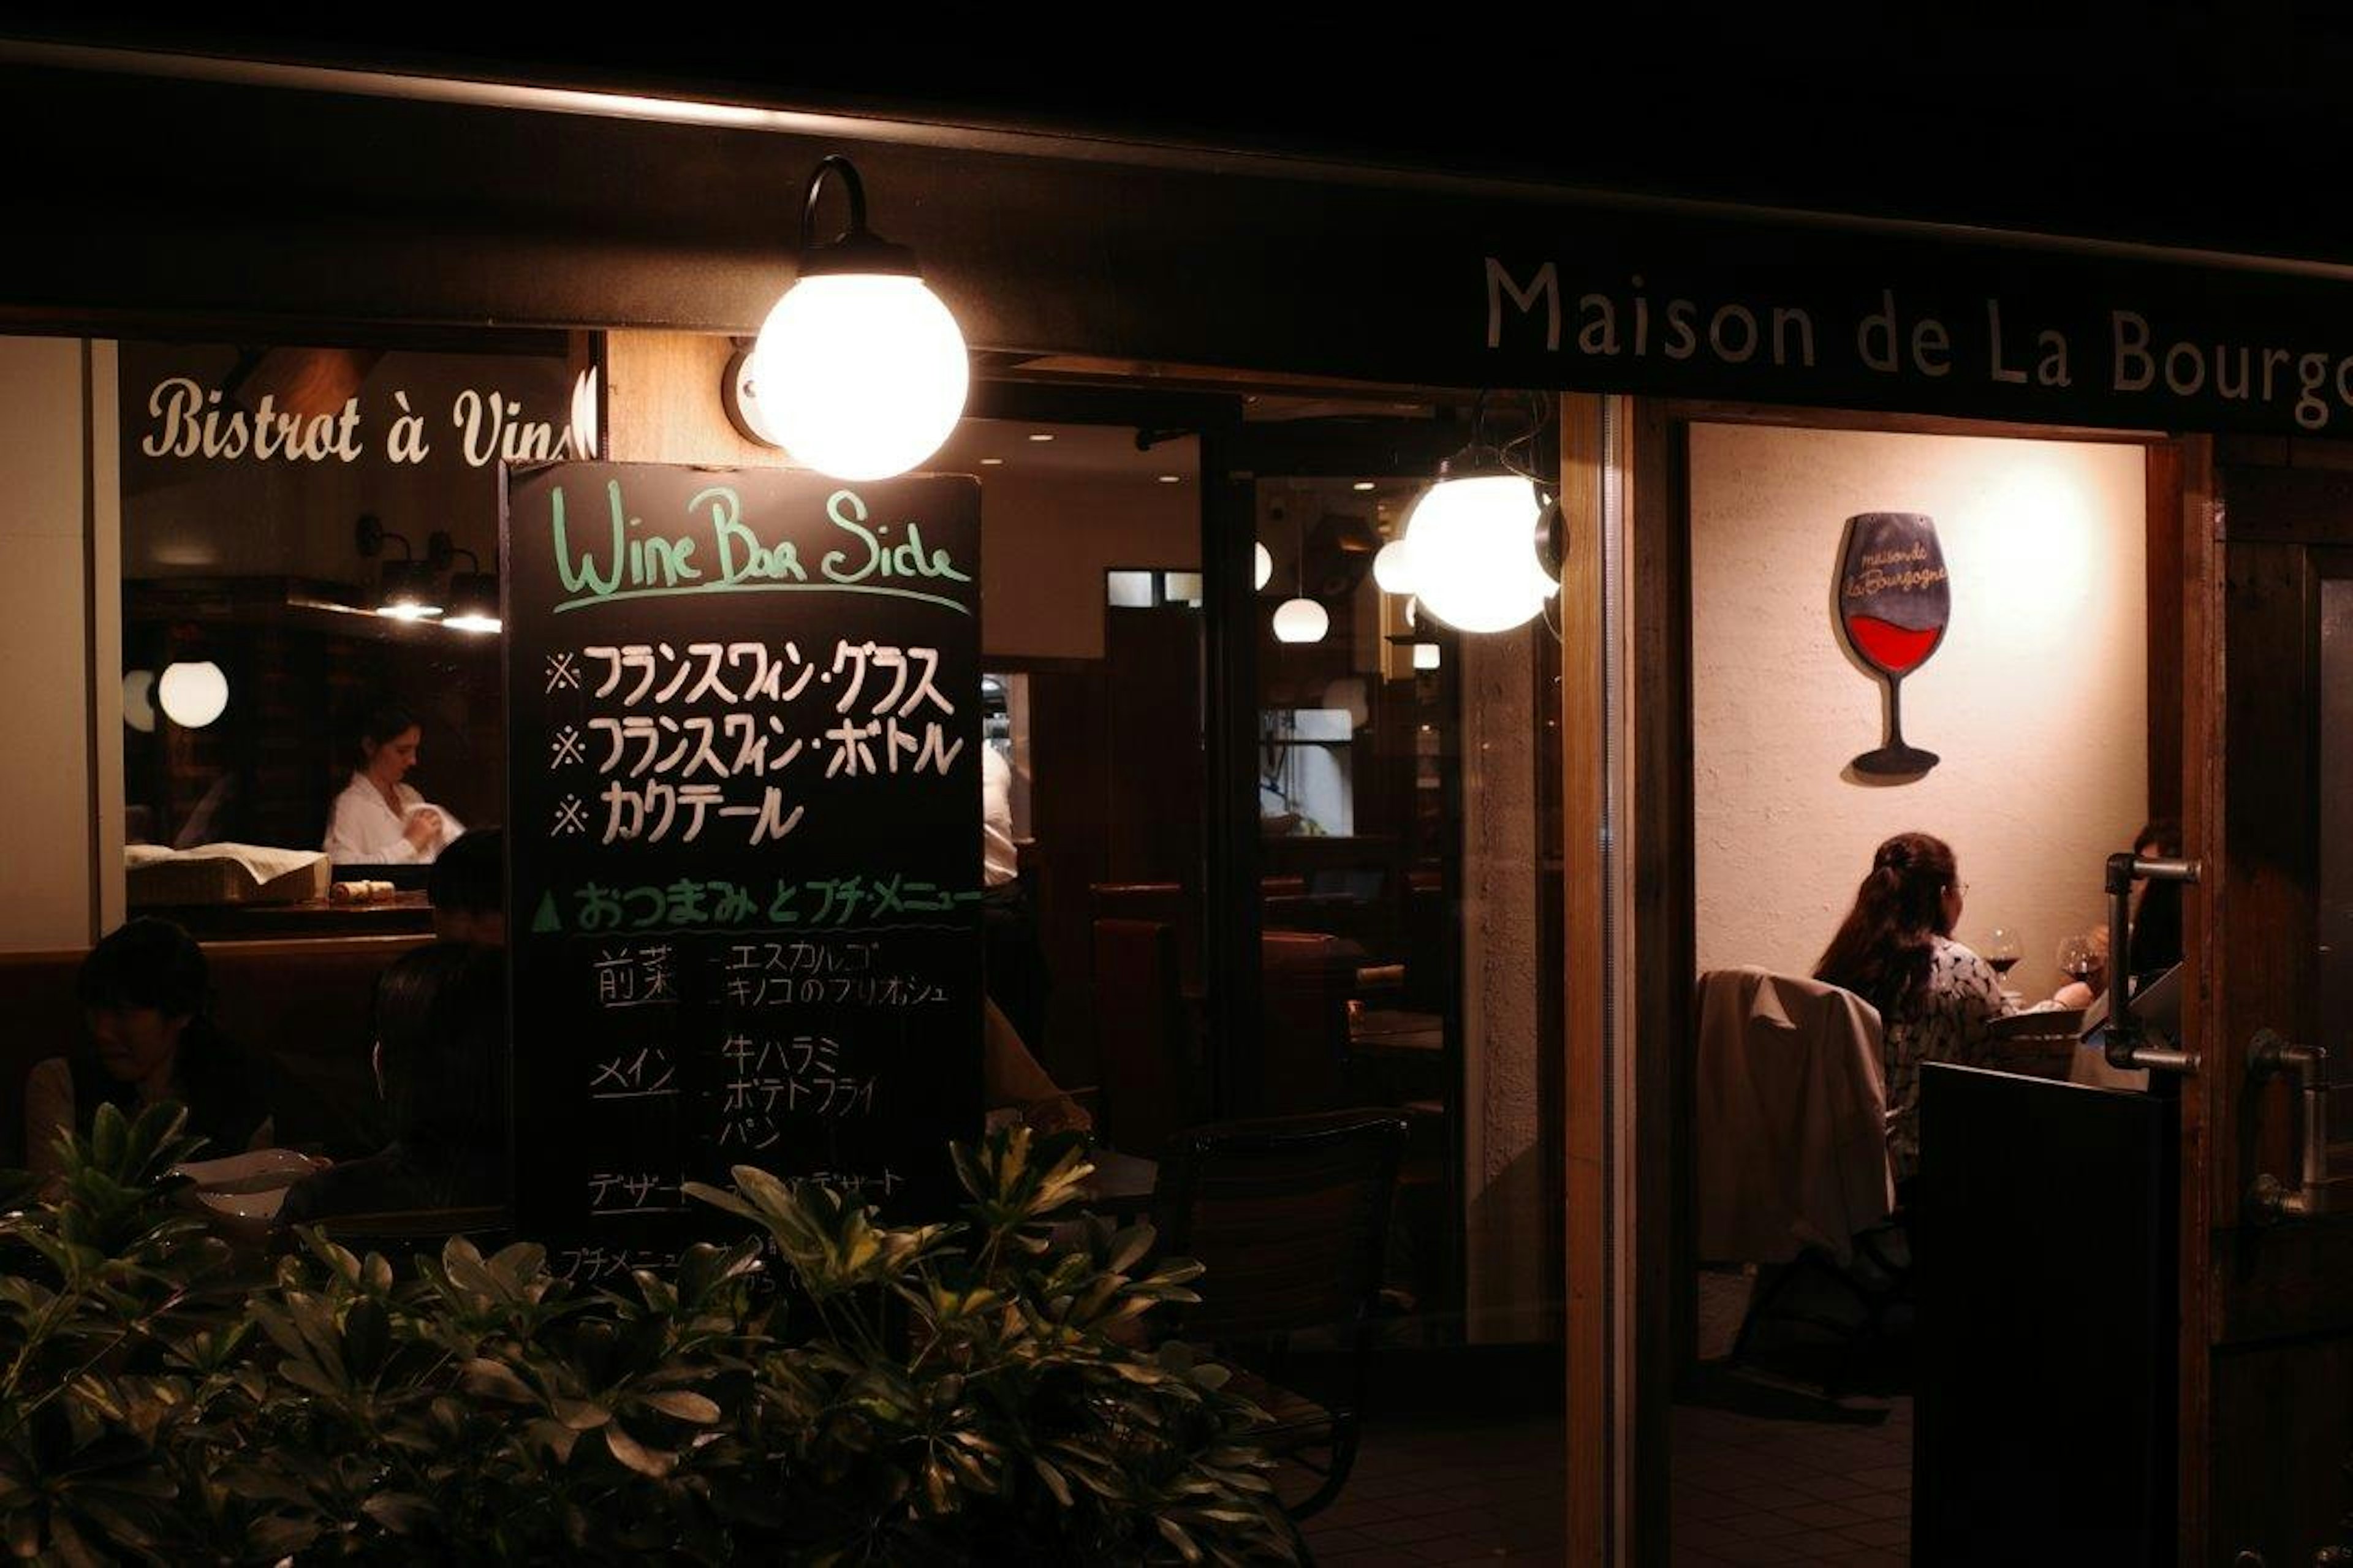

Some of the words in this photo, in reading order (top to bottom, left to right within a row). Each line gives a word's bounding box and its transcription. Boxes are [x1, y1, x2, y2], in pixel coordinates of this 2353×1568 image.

[1484, 255, 1815, 368] Maison
[1857, 287, 1952, 377] de
[1987, 297, 2072, 387] La
[142, 377, 363, 460] Bistrot
[387, 390, 428, 463] à
[552, 480, 702, 596] Wine
[688, 487, 808, 585] Bar
[821, 490, 971, 583] Side
[590, 1047, 676, 1092] メイン
